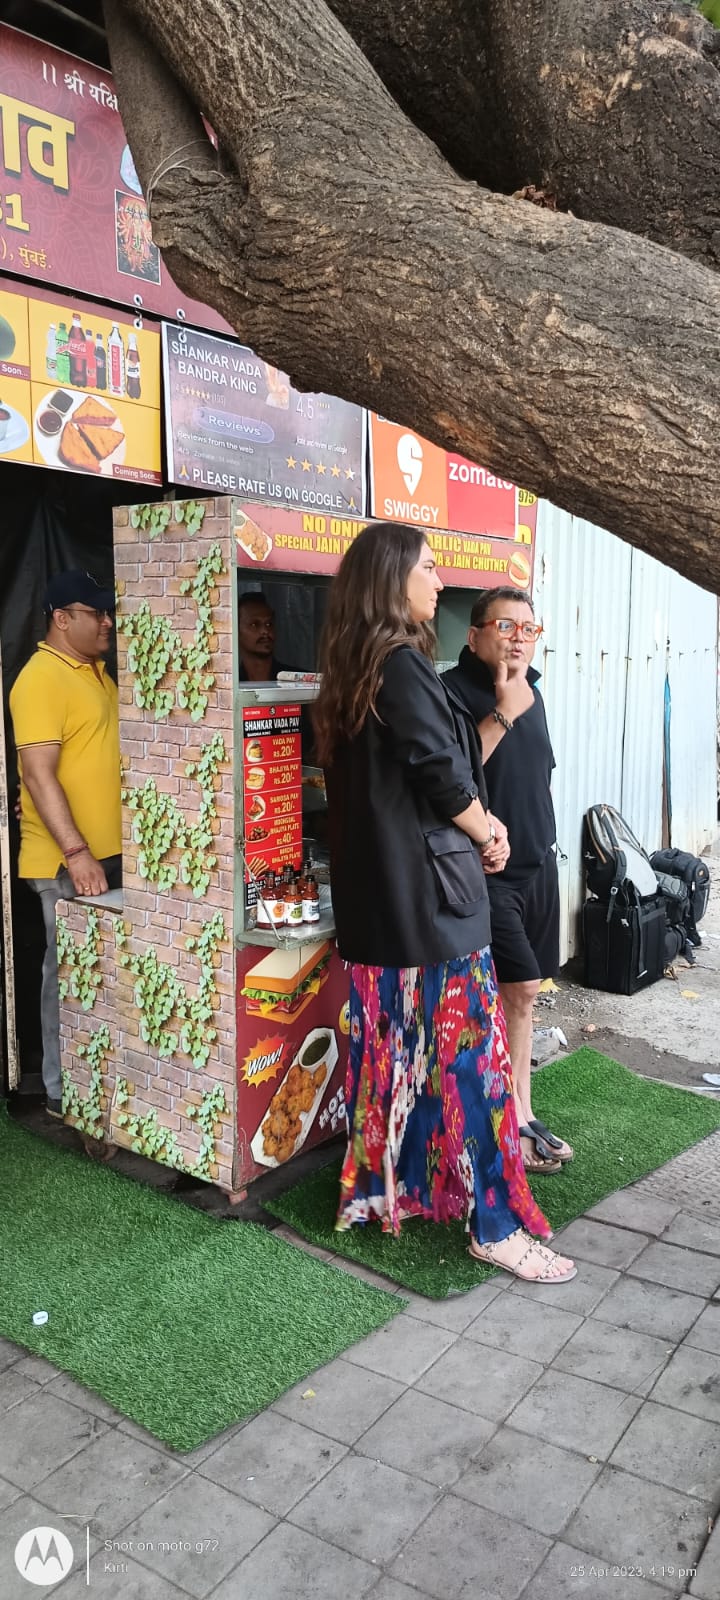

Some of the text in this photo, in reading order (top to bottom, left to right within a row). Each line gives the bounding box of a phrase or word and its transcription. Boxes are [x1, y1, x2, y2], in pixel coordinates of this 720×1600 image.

[64, 70, 86, 97] श्री
[0, 193, 30, 232] 1
[172, 340, 262, 379] SHANKAR VADA
[178, 360, 257, 394] BANDRA KING
[297, 396, 314, 420] 4.5
[177, 430, 208, 443] Reviews
[208, 437, 225, 448] from
[226, 441, 238, 451] the
[208, 415, 262, 436] Reviews
[192, 468, 342, 508] PLEASE RATE US ON GOOGLE
[384, 498, 439, 523] SWIGGY
[303, 514, 492, 556] NO ONIO ARLIC VADA PAV
[274, 533, 313, 551] SPECIAL
[315, 535, 341, 554] JAIN
[453, 553, 471, 569] JAIN
[473, 556, 509, 573] CHUTNEY
[244, 716, 300, 732] SHANKAR VADA PAV
[273, 736, 295, 746] VADA PAV
[247, 1043, 283, 1077] WOW!
[319, 1085, 345, 1130] HOT
[330, 1102, 346, 1131] FO
